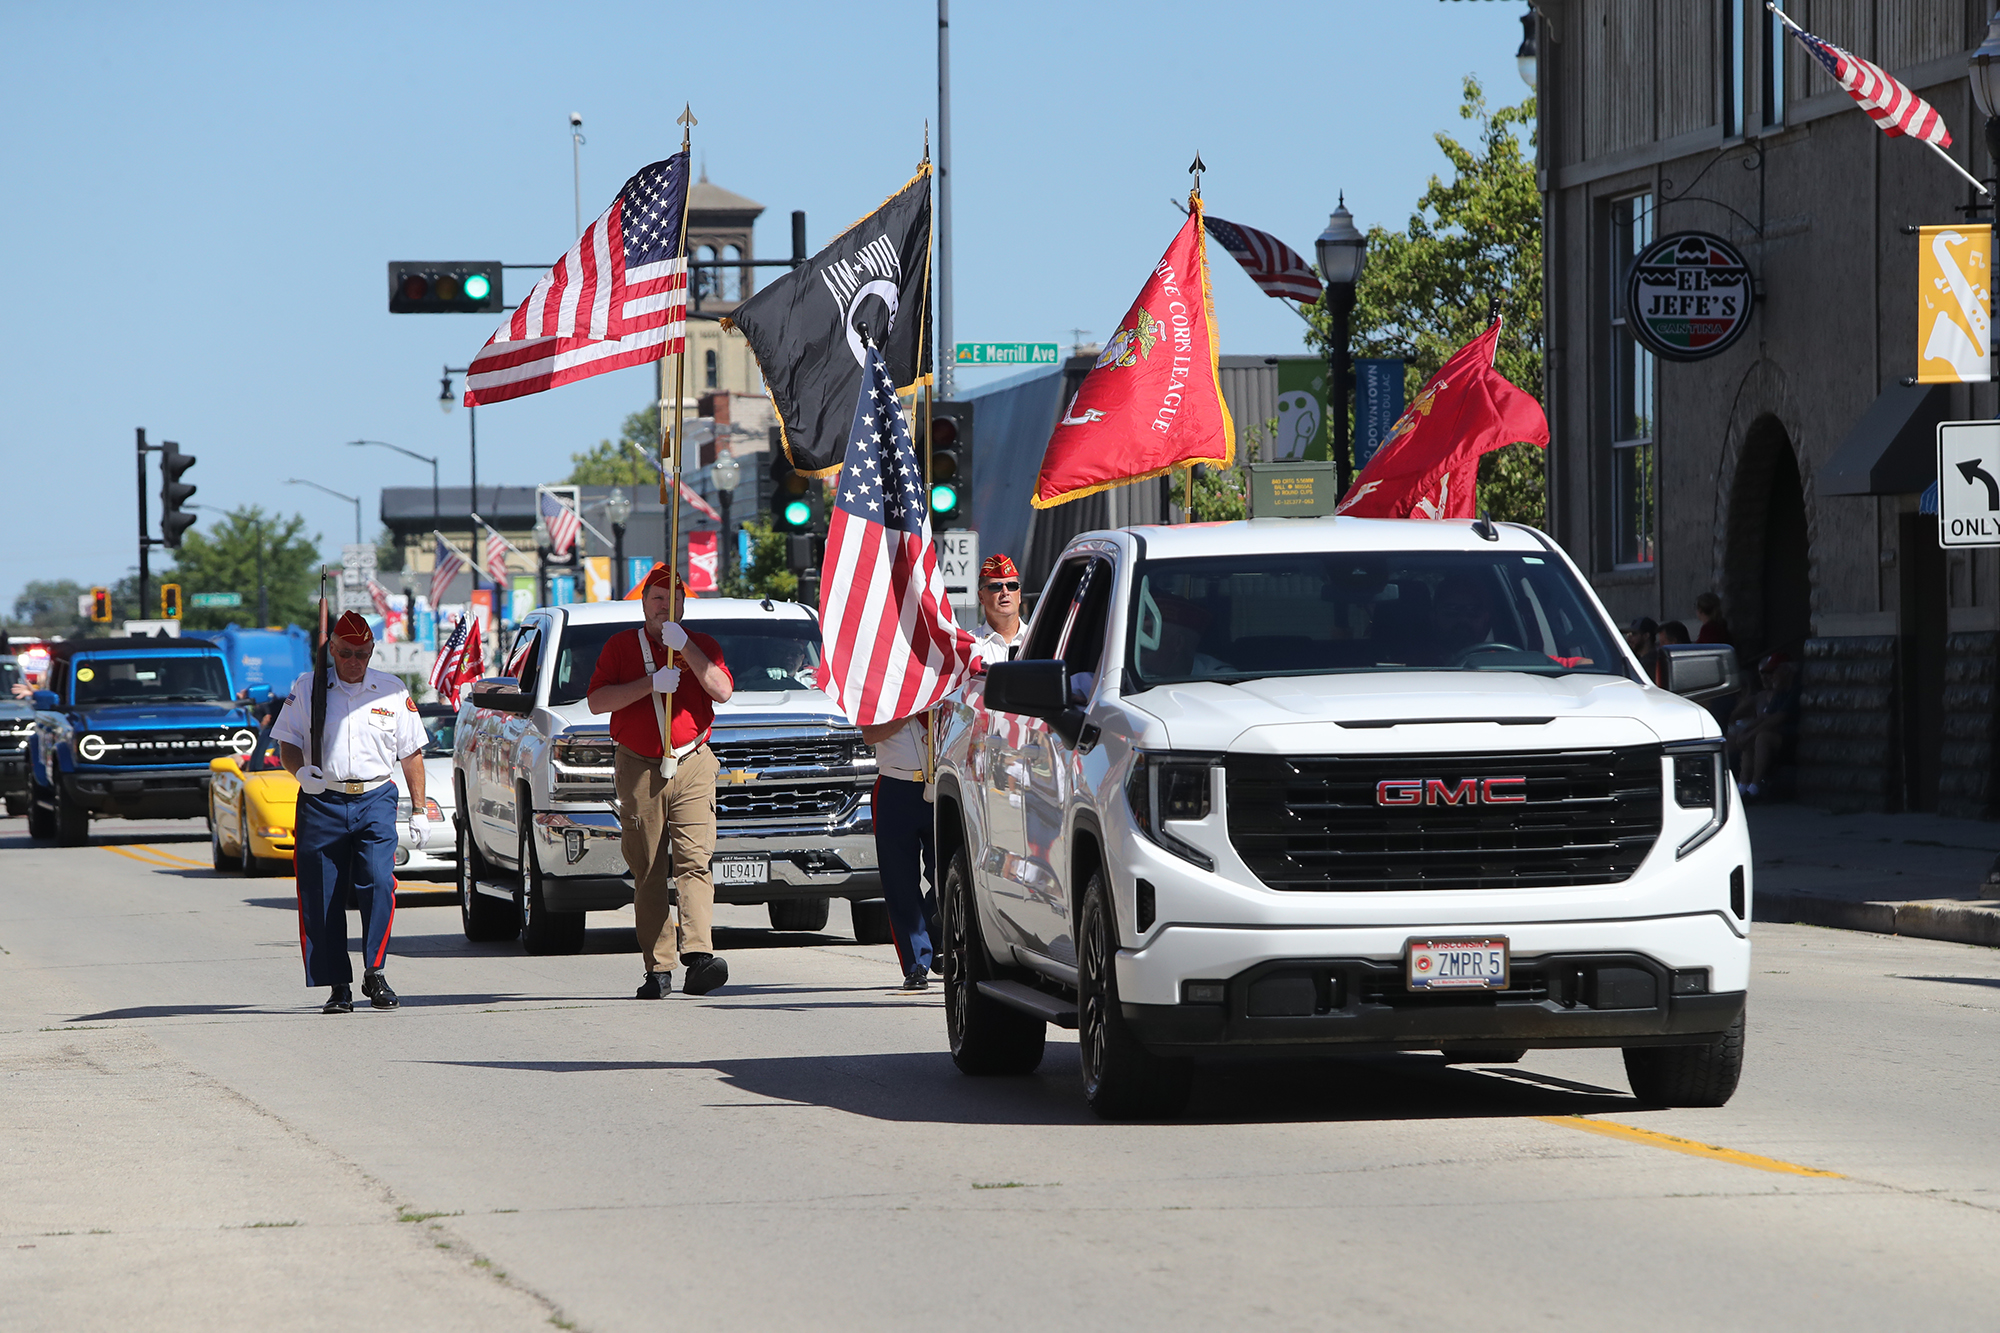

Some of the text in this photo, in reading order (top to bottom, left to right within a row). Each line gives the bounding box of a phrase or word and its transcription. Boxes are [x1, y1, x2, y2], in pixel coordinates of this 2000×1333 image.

[1677, 270, 1709, 291] EL
[1647, 295, 1737, 316] JEFE'S
[1656, 323, 1724, 335] CANTINA
[973, 345, 1056, 362] E Merrill Ave
[1151, 258, 1192, 434] RINE CORPS LEAGUE
[1382, 373, 1391, 393] LAC
[1367, 364, 1378, 447] DOWNTOWN
[1382, 394, 1391, 409] DU
[123, 740, 216, 750] BRONCO
[1376, 777, 1526, 806] GMC
[722, 863, 764, 879] UE9417
[1438, 952, 1483, 976] ZMPR
[1489, 952, 1500, 975] 5
